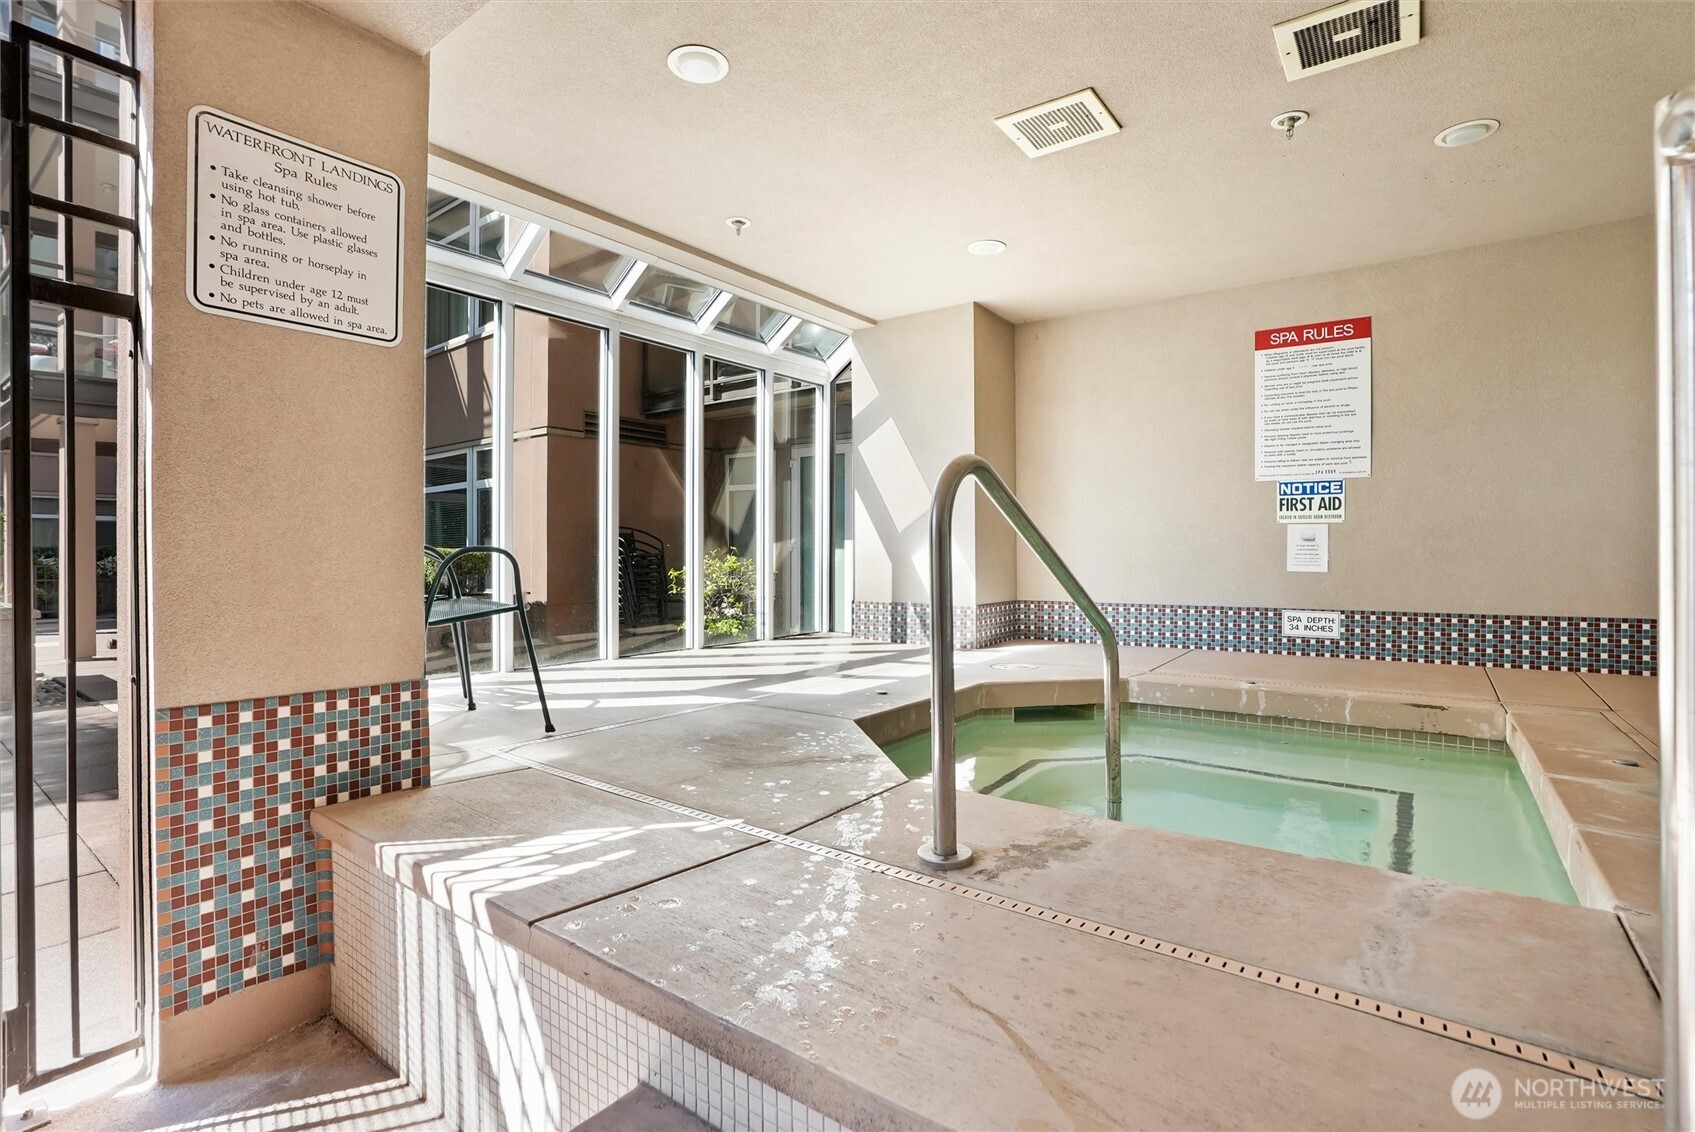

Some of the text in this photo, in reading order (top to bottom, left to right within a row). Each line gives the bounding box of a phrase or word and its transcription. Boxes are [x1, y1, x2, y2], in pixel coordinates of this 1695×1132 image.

[203, 120, 394, 194] WATERFRONT LANDINGS
[221, 166, 376, 221] Take cleansing shower before
[221, 182, 300, 210] using hot tub.
[274, 162, 338, 192] Spa Rules
[220, 222, 286, 245] and bottles.
[221, 194, 367, 244] No glass containers allowed
[221, 208, 378, 258] in spa area. Use plastic glasses
[220, 235, 238, 248] No
[242, 244, 288, 263] running
[308, 257, 354, 279] horseplay
[358, 270, 367, 280] in
[220, 251, 270, 268] spa area.
[220, 264, 368, 306] Children under age 12 must
[220, 276, 360, 315] be supervised by an adult.
[220, 292, 388, 334] No pets are allowed in spa area.
[1270, 324, 1354, 345] SPA RULES
[1280, 482, 1342, 494] NOTICE
[1280, 496, 1342, 512] FIRST AID
